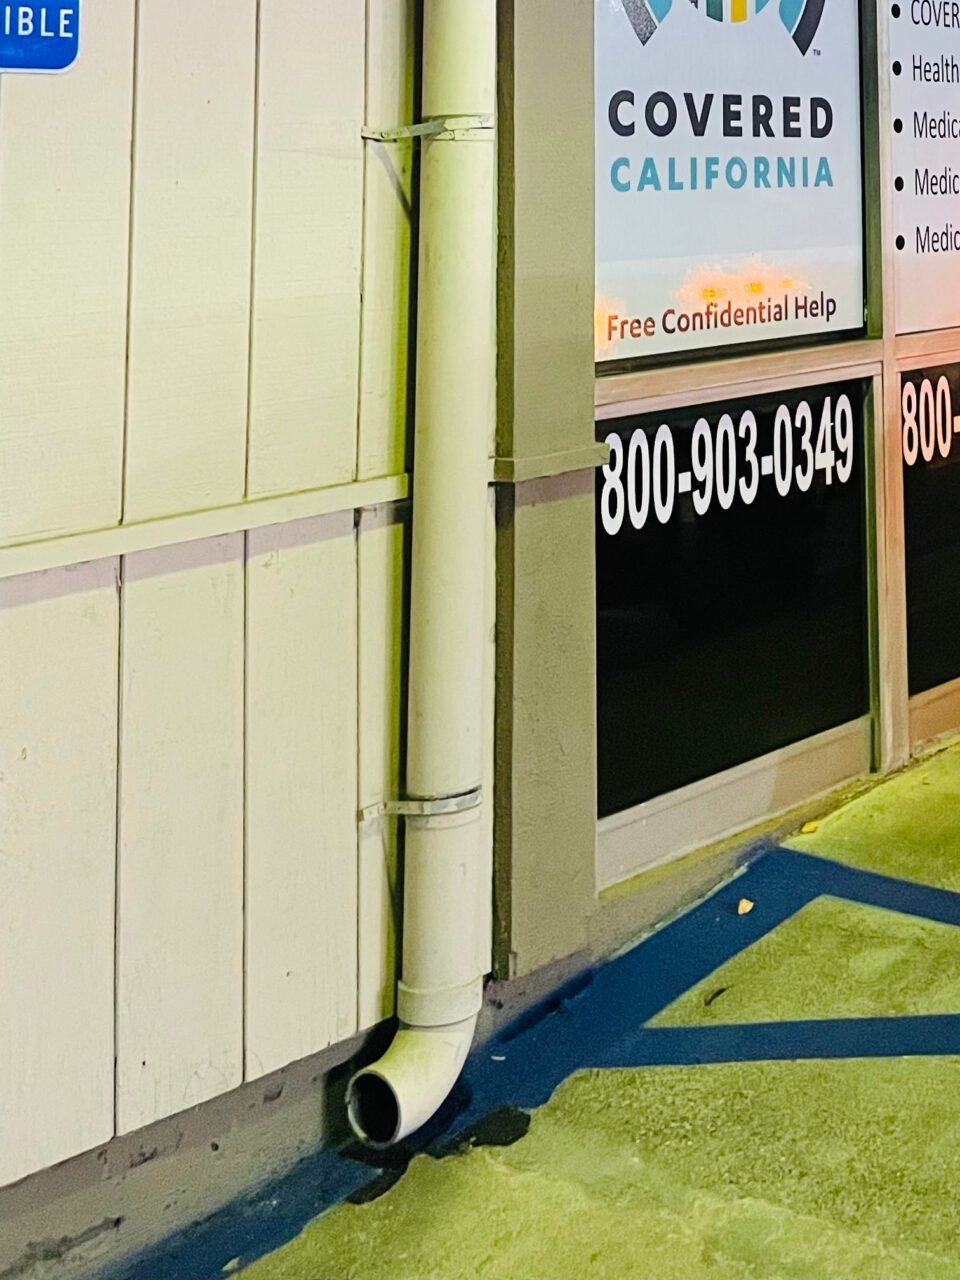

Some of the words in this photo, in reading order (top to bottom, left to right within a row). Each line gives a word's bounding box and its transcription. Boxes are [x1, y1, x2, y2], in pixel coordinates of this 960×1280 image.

[912, 54, 960, 83] Health
[608, 90, 833, 138] COVERED
[610, 156, 834, 192] CALIFORNIA
[607, 315, 655, 341] Free
[662, 294, 788, 334] Confidential
[795, 291, 837, 322] Help
[601, 394, 854, 536] 800-903-0349
